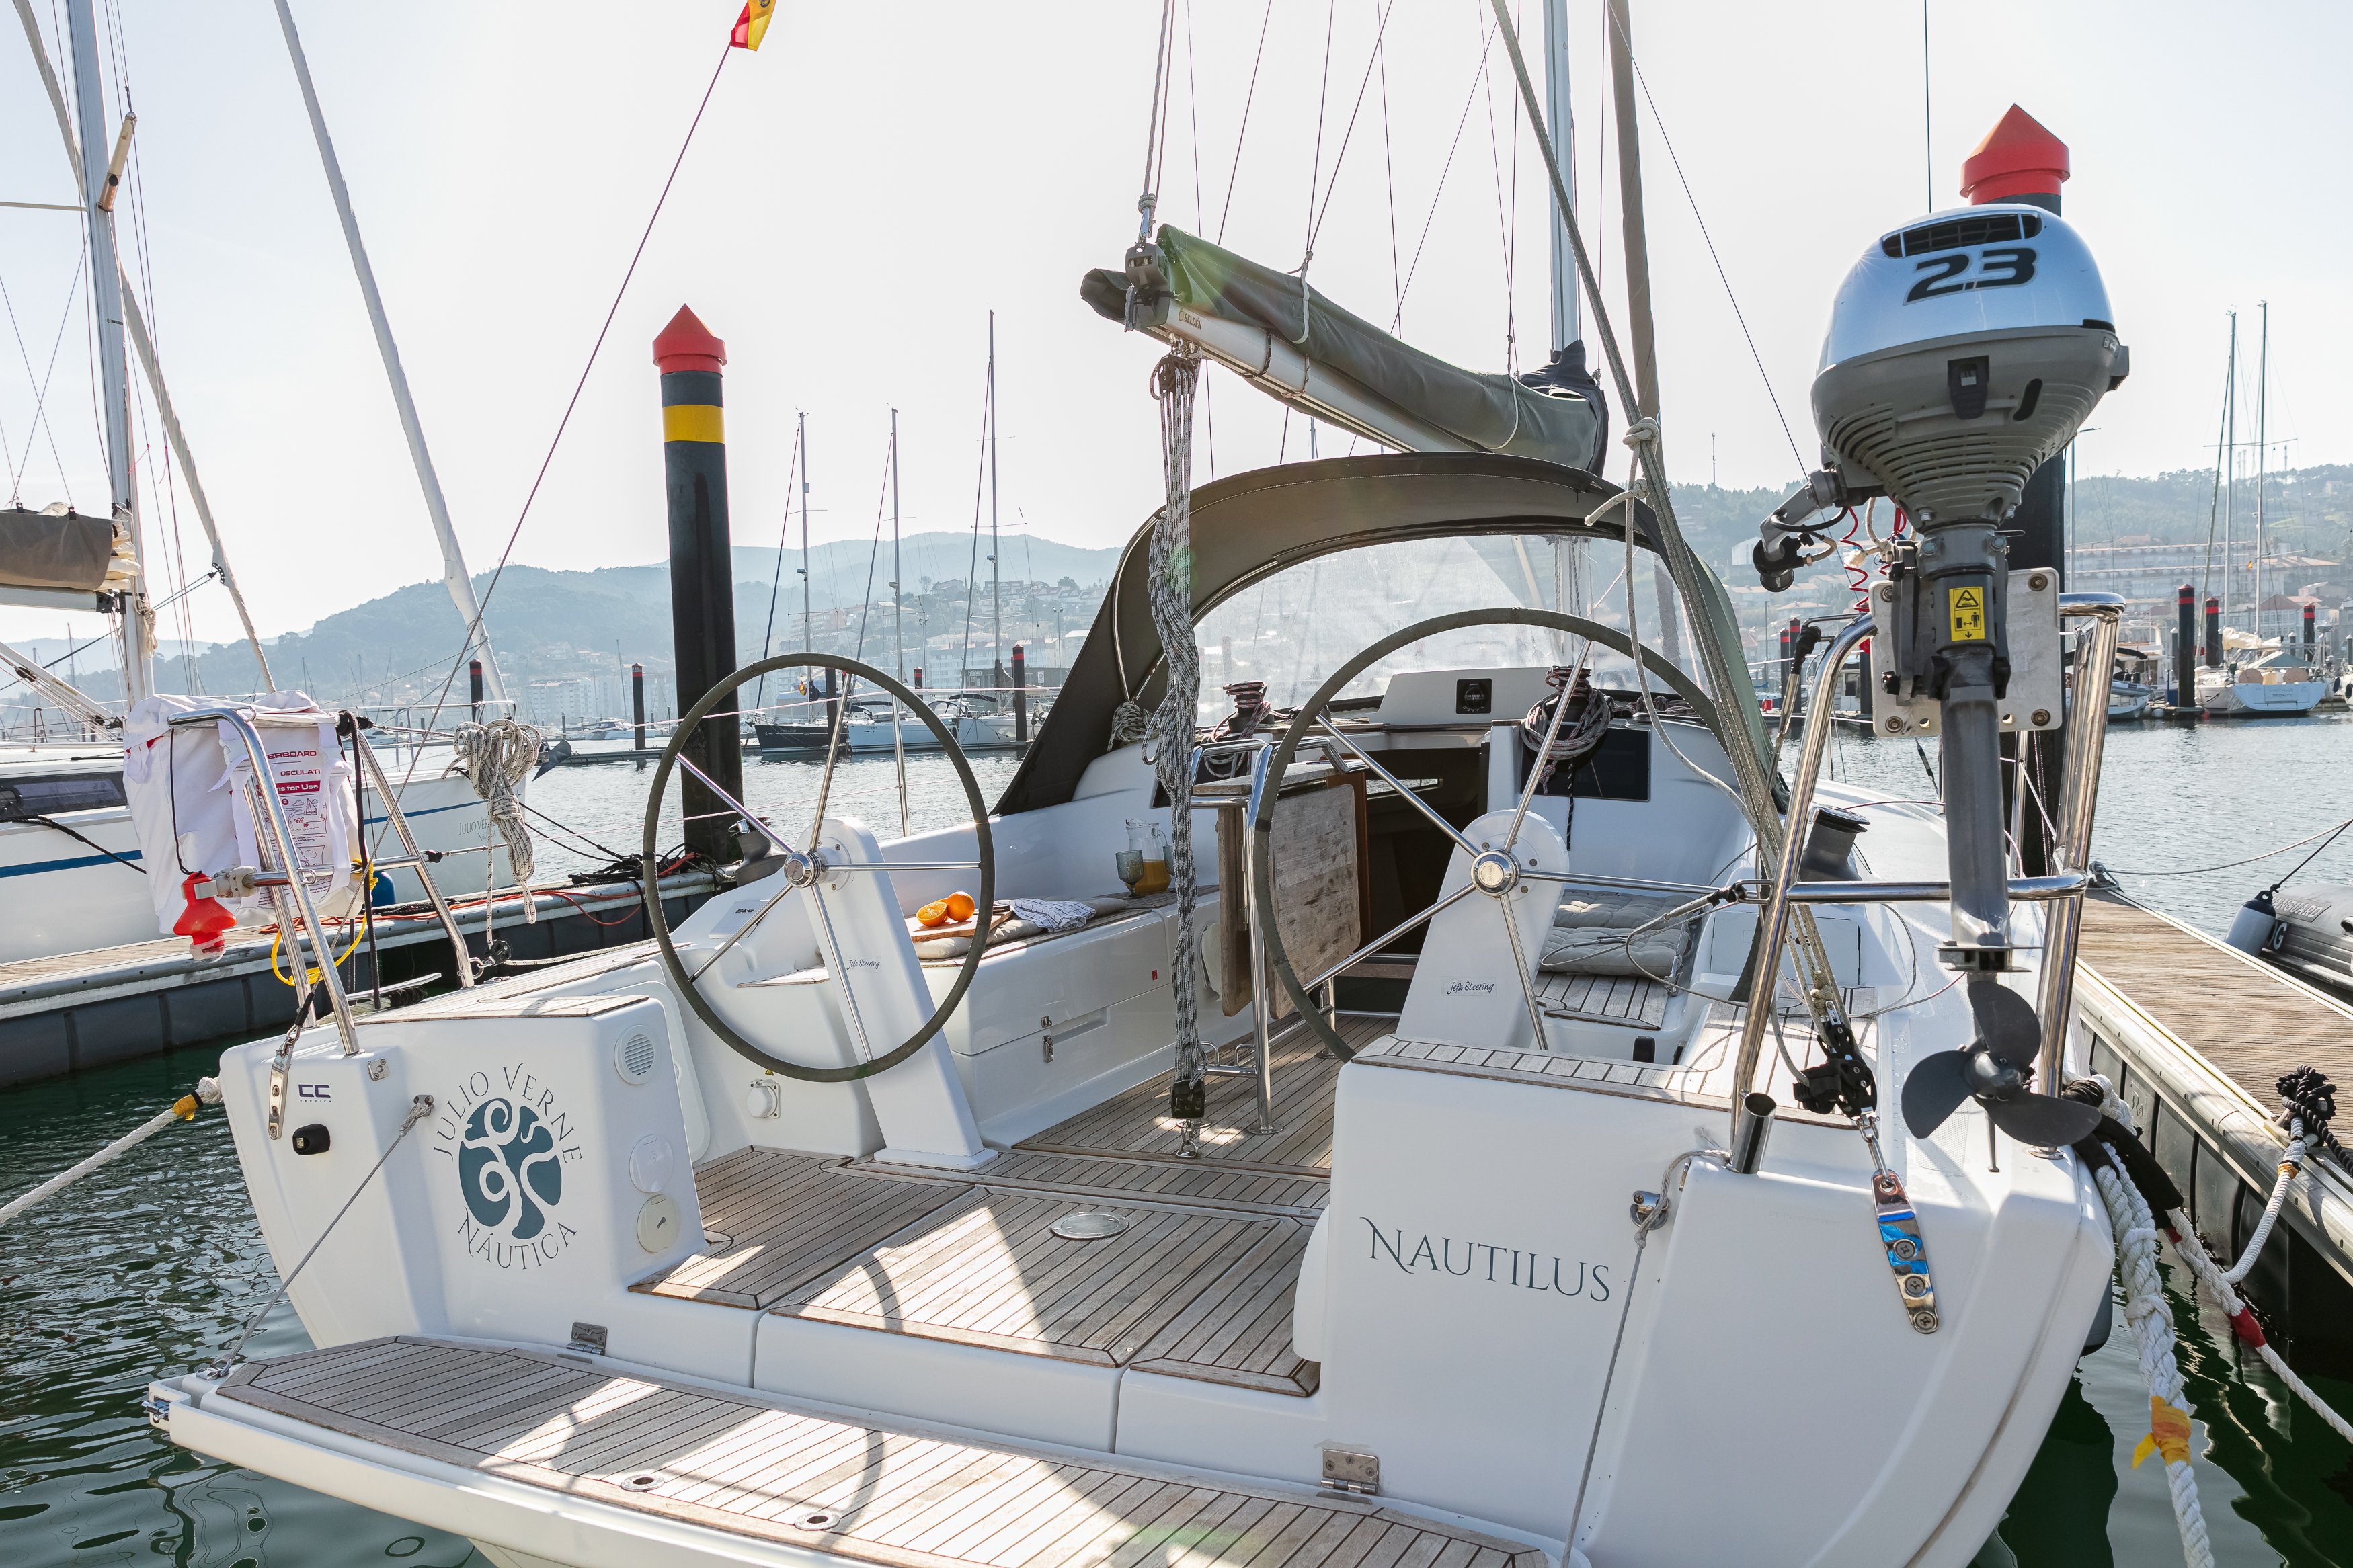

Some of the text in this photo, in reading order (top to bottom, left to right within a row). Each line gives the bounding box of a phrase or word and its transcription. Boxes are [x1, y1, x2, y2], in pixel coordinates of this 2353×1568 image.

[1903, 247, 2040, 306] 2.3
[266, 750, 317, 759] ERBOARD
[458, 821, 477, 835] JULIO
[859, 959, 880, 970] Steering
[1464, 981, 1494, 993] Steering
[434, 1062, 583, 1164] JULIO VERNE
[457, 1206, 577, 1270] NÁUTICA
[1359, 1216, 1609, 1302] NAUTILUS
